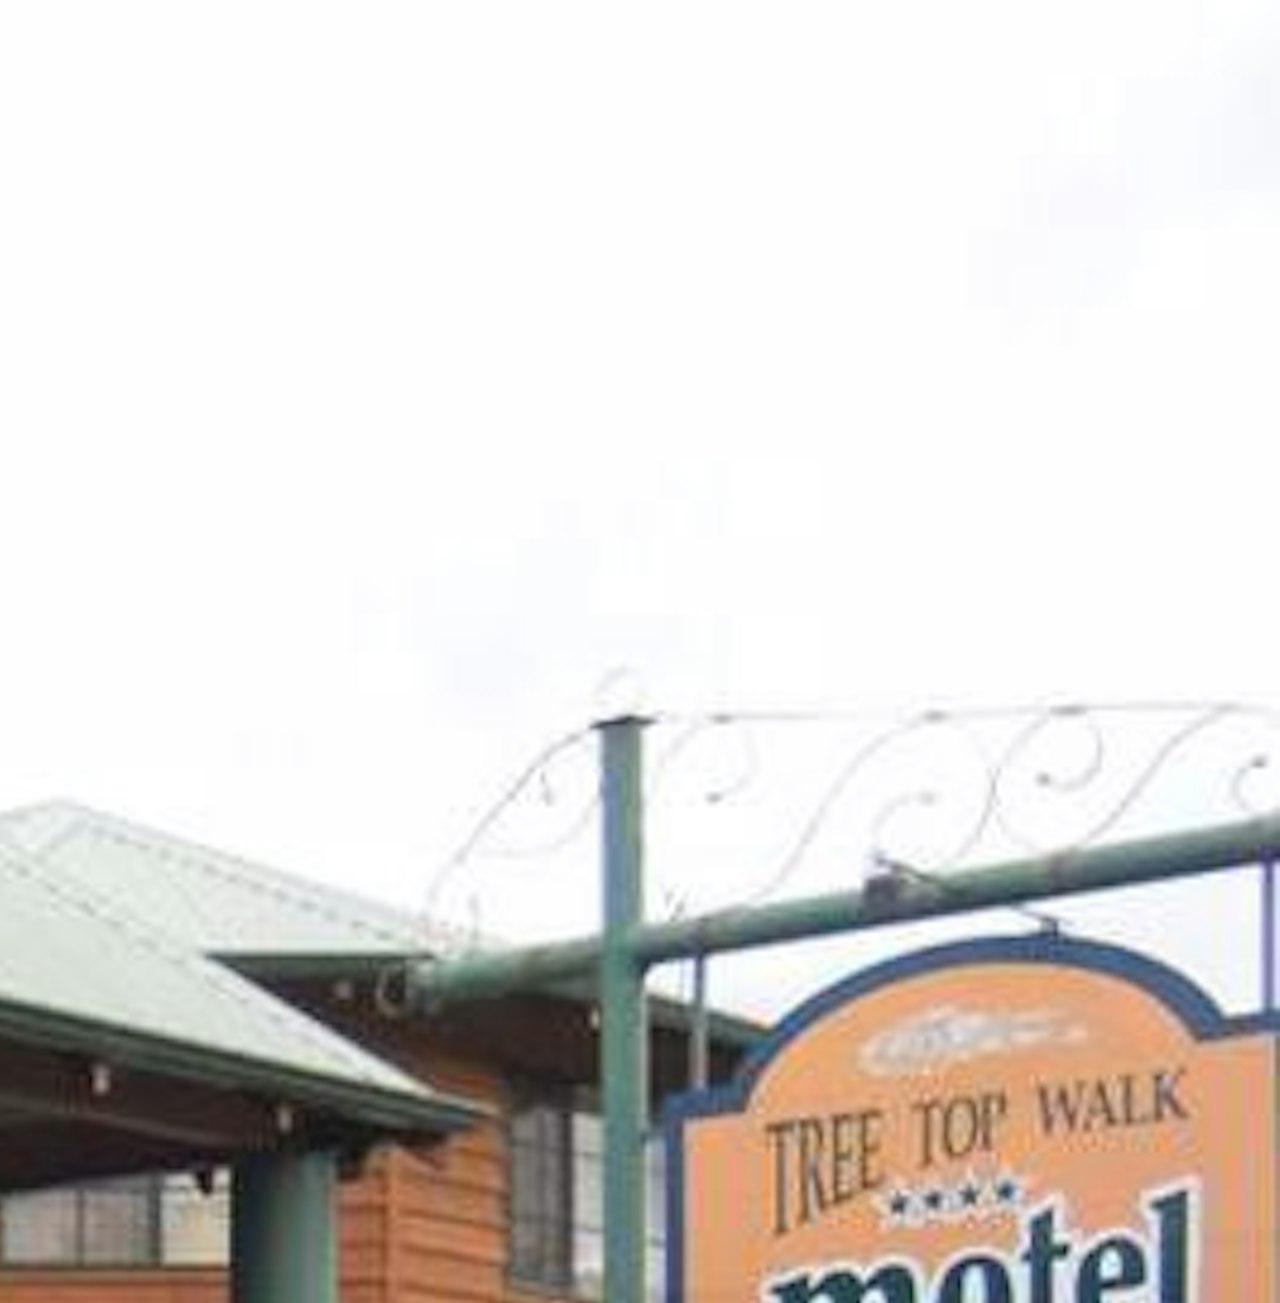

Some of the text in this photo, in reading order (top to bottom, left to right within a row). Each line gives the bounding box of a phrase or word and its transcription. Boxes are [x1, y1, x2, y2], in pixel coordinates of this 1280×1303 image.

[765, 1068, 1190, 1237] TREE TOP WALK
